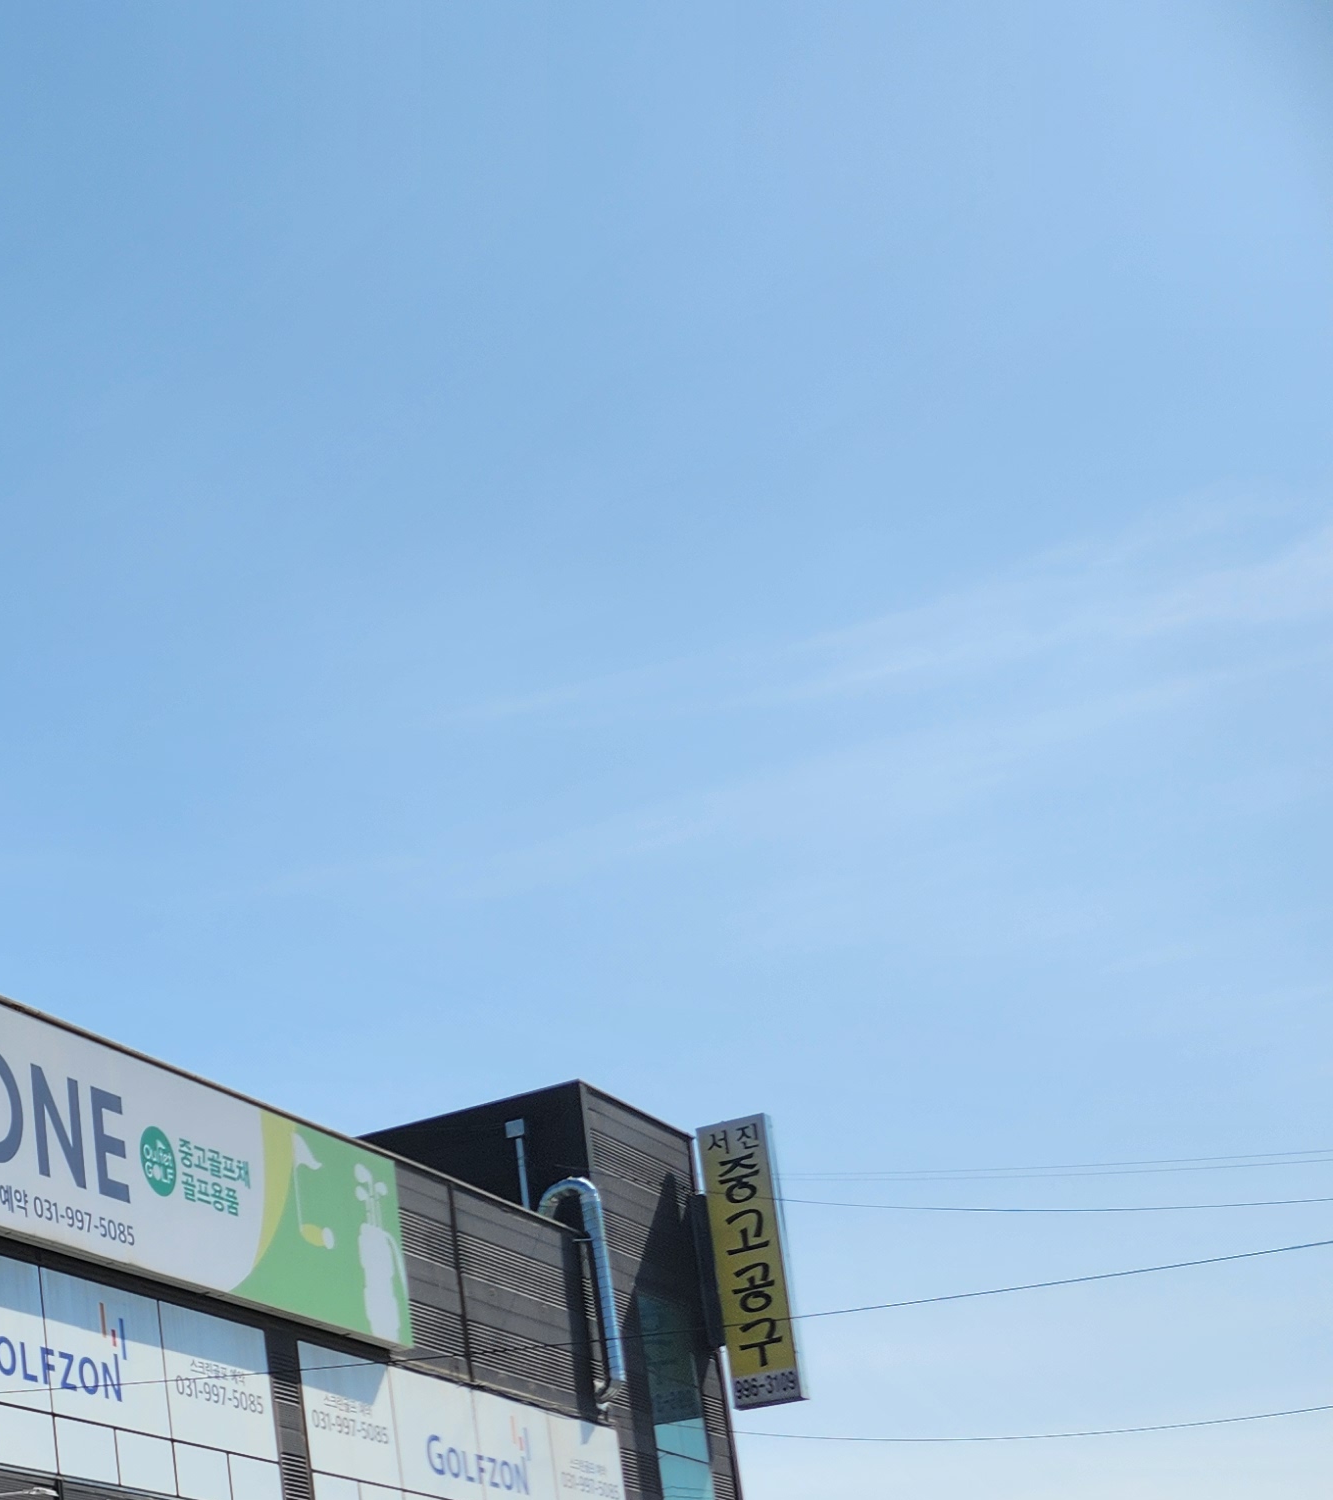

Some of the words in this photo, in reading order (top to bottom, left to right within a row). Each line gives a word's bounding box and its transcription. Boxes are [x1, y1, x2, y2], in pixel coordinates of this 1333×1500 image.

[178, 1137, 251, 1189] 중고골프채
[708, 1123, 759, 1154] 서진
[0, 1184, 28, 1218] 예약
[34, 1195, 135, 1246] 031-997-5085
[181, 1171, 239, 1217] 골프용품
[718, 1152, 783, 1367] 중고공구
[176, 1375, 265, 1415] 031-997-5085
[311, 1409, 389, 1444] 031-997-5085
[427, 1434, 530, 1495] GOLFZON
